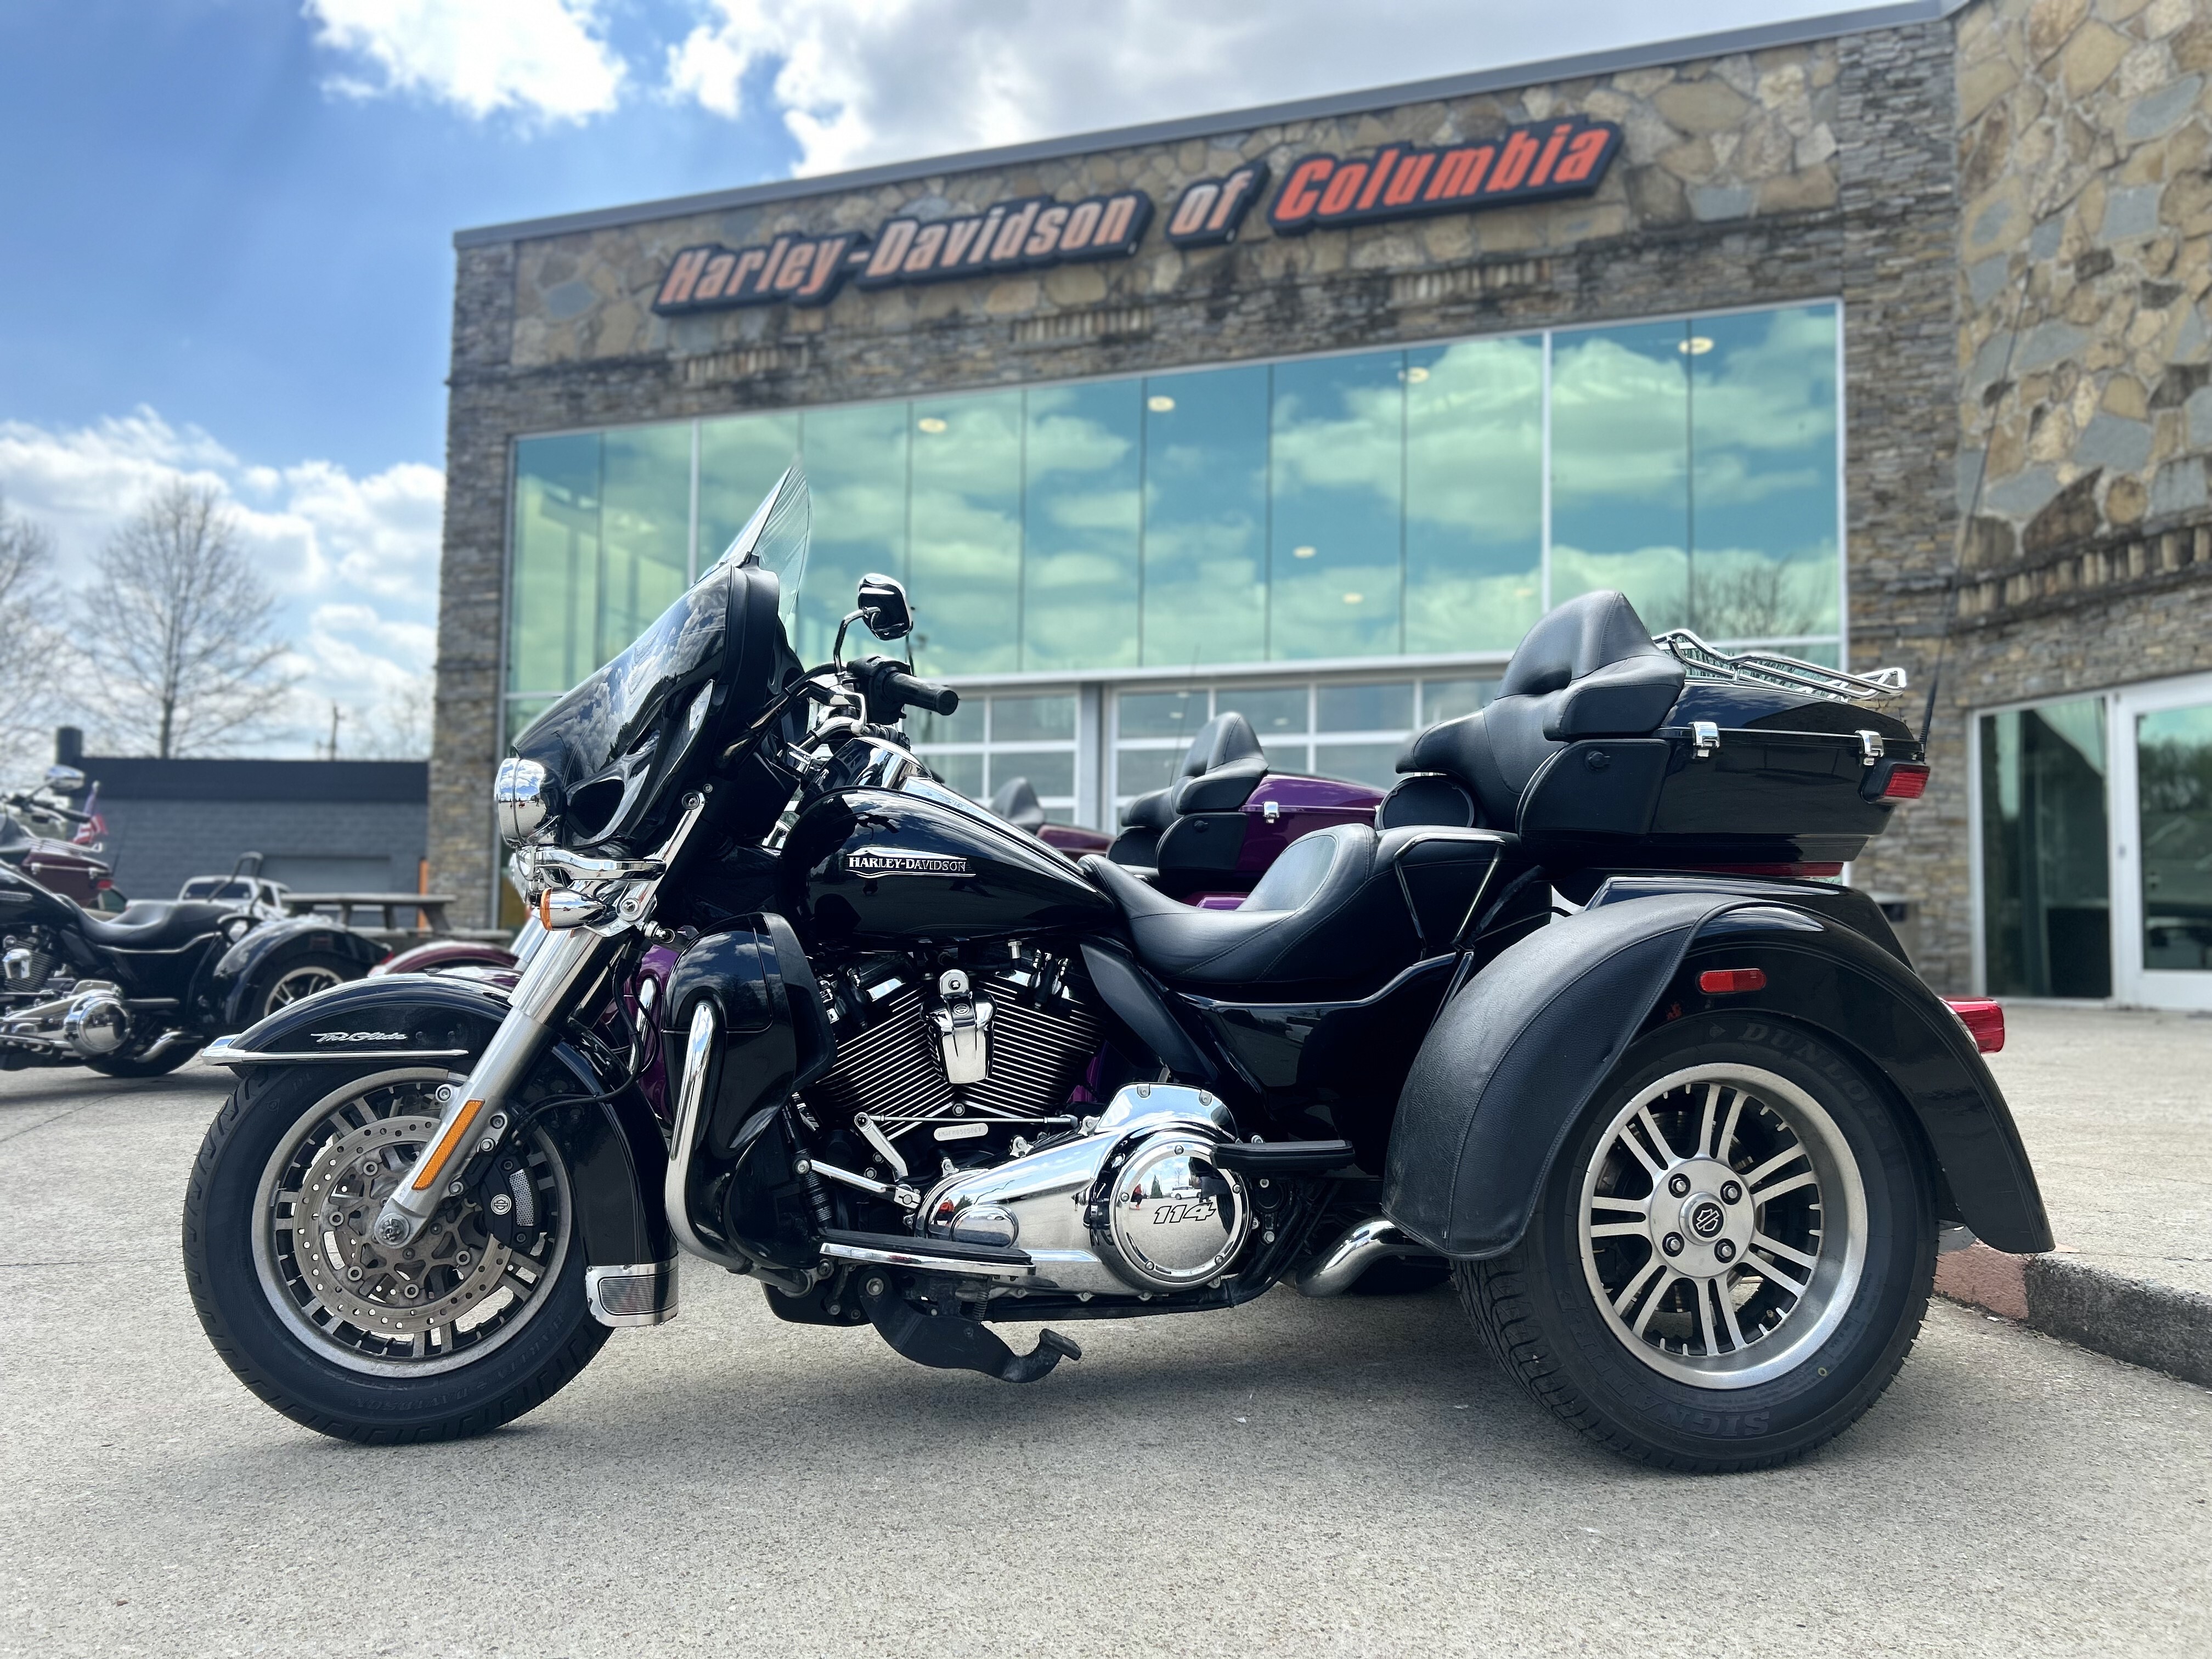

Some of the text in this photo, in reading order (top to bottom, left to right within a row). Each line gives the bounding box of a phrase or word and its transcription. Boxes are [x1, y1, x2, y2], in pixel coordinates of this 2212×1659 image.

[657, 124, 1611, 305] Harley-Davidson of Columbia
[849, 857, 966, 872] HARLEY-DAVIDSON
[1737, 1022, 1889, 1129] DUNLOP
[1153, 1201, 1217, 1224] 114
[1554, 1288, 1771, 1437] SIGNATURE
